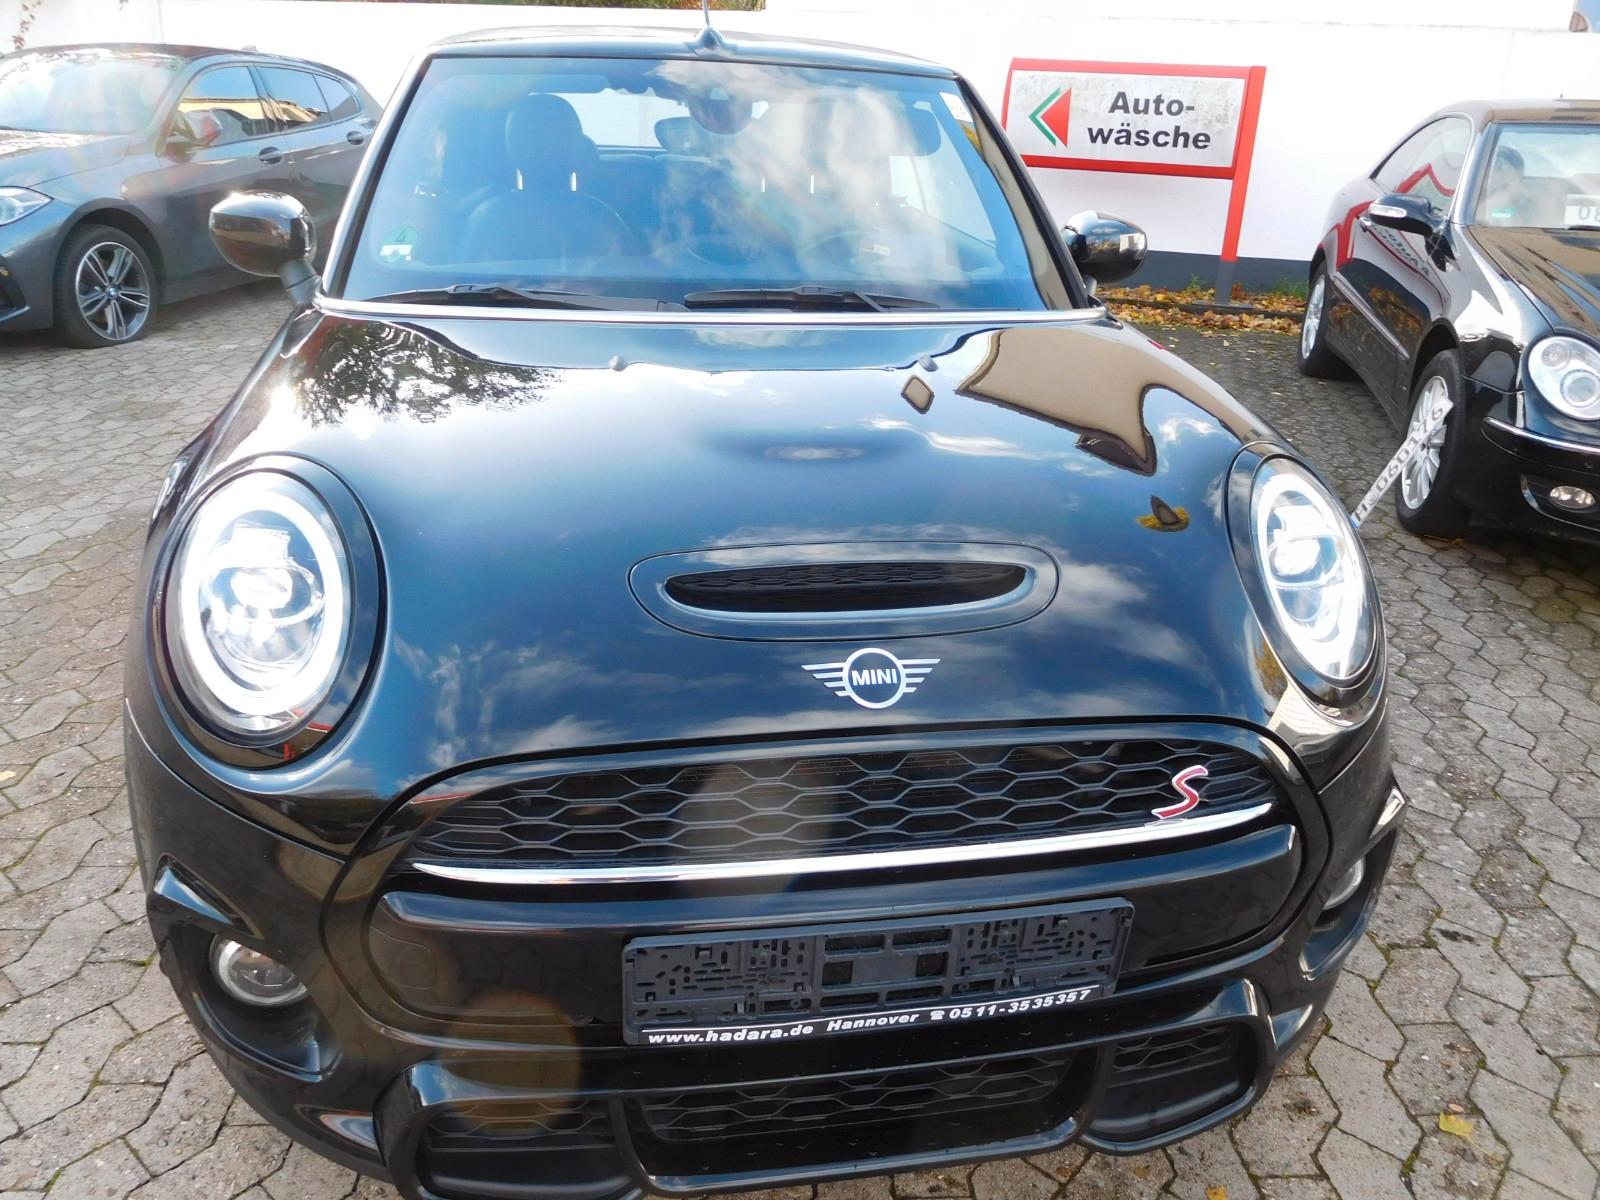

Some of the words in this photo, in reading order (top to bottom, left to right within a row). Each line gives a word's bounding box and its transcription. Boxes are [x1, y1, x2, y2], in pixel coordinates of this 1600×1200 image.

[1108, 91, 1196, 116] Auto-
[1087, 122, 1211, 150] wäsche
[851, 668, 898, 686] MINI
[1151, 764, 1209, 820] S
[648, 1024, 814, 1044] www.hadara.de
[826, 1013, 920, 1032] Hannover
[949, 989, 1092, 1020] 0511-3535357
